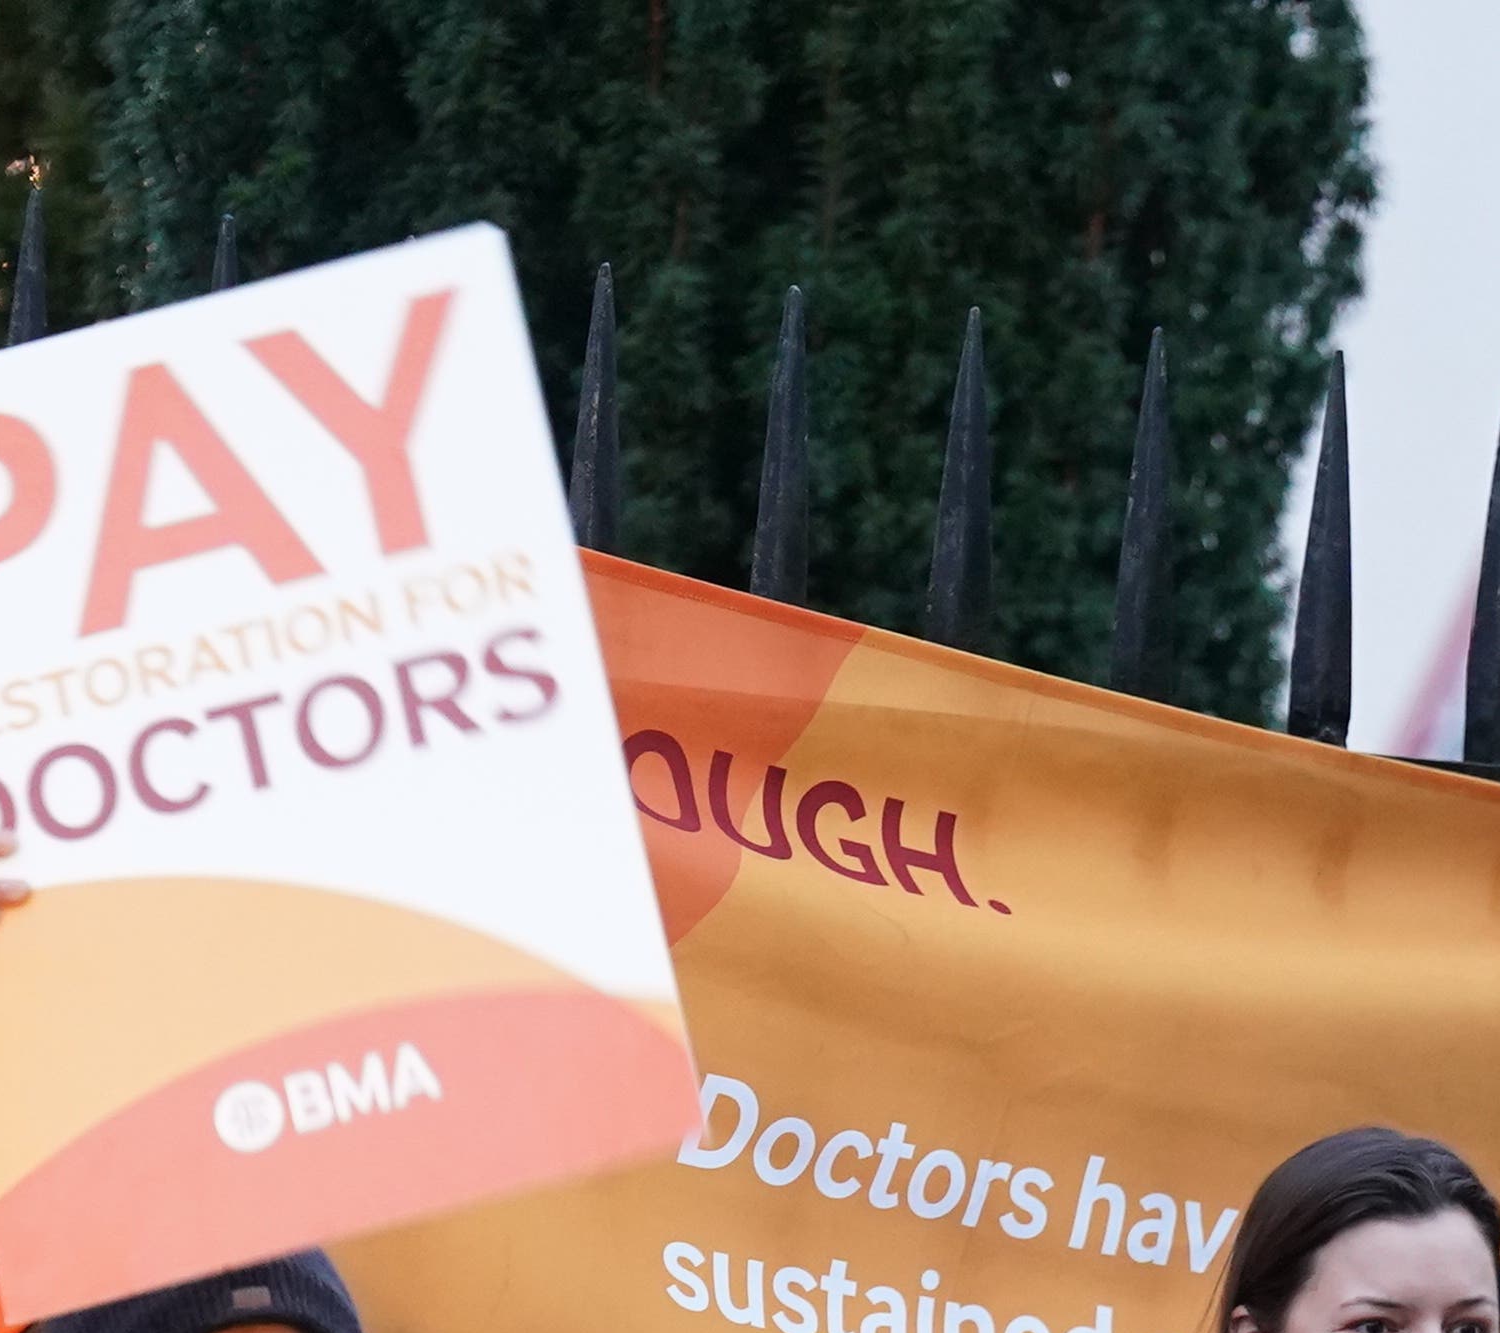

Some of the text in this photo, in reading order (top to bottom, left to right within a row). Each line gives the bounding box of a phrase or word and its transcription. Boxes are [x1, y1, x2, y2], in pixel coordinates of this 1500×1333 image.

[404, 552, 537, 629] FOR
[283, 1042, 442, 1134] BMA
[677, 1072, 1053, 1240] Doctors
